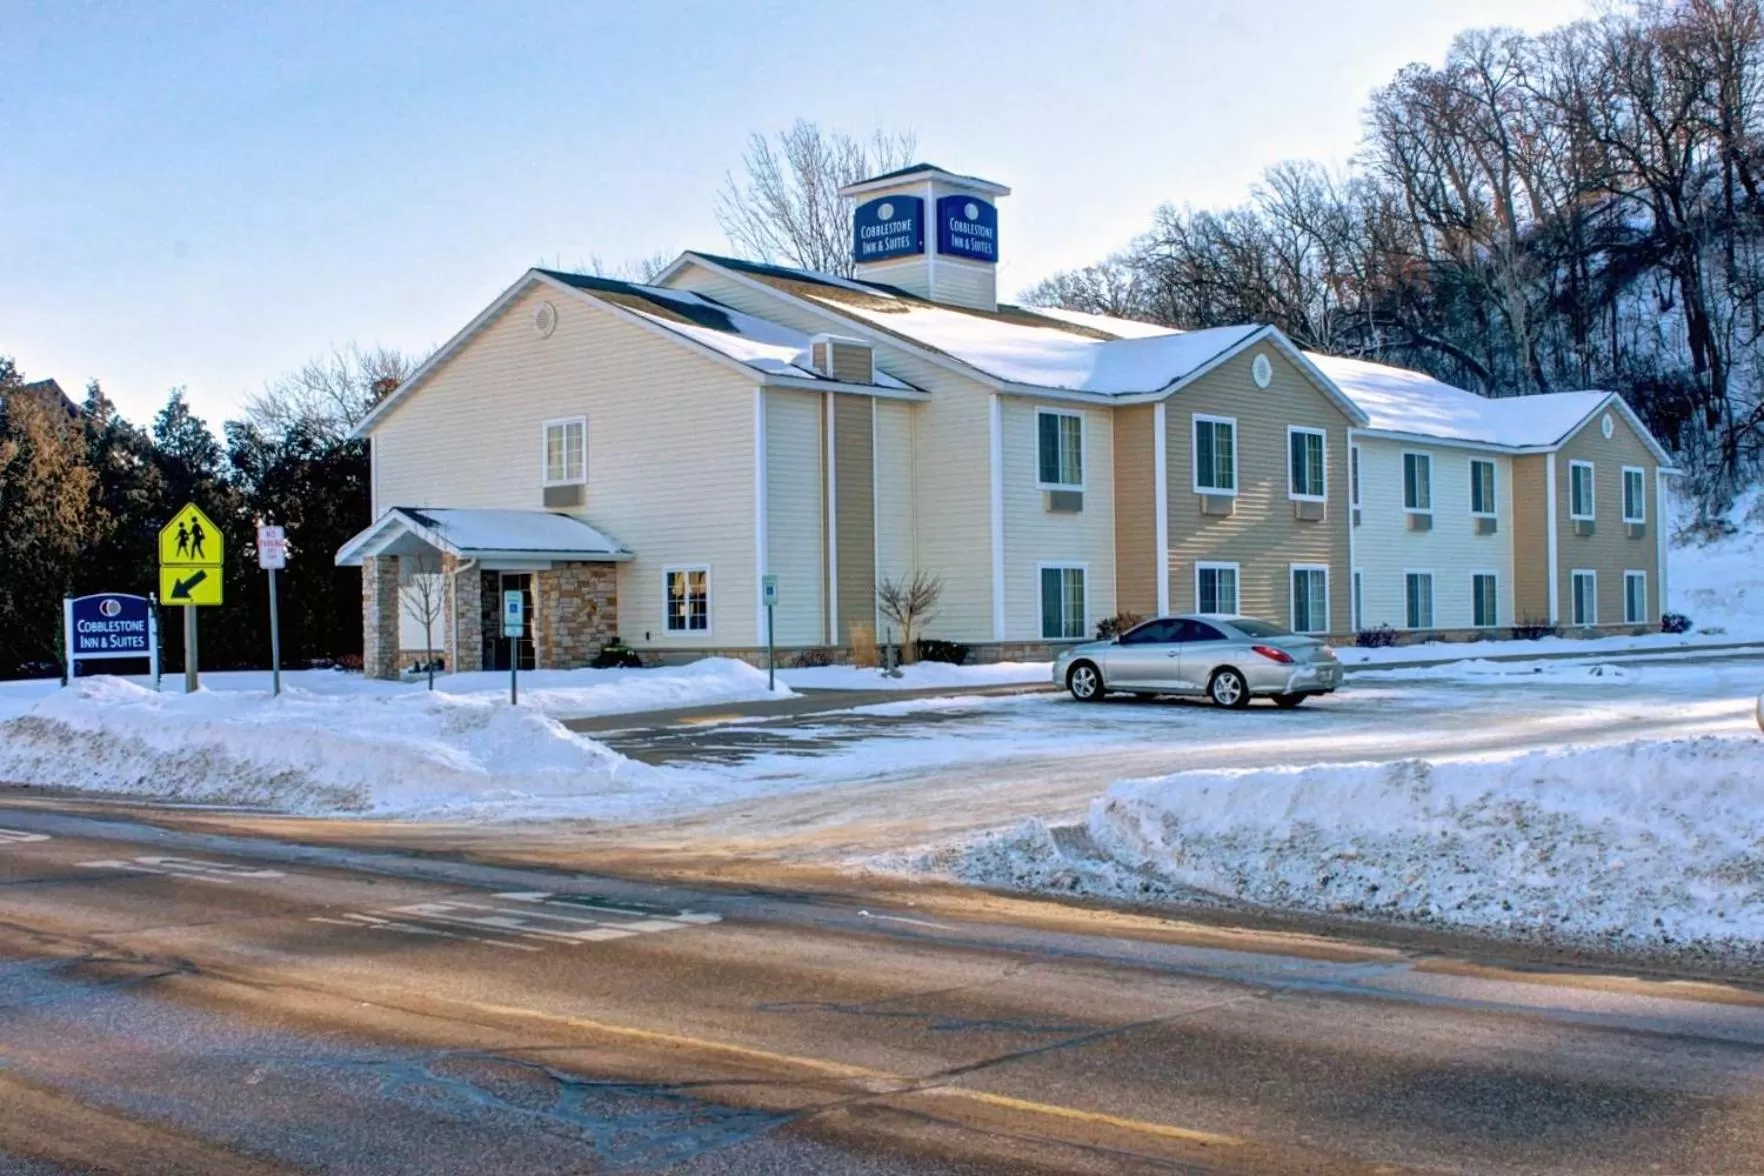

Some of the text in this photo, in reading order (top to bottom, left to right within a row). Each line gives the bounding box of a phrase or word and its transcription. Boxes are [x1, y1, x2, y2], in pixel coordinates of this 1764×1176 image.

[860, 219, 912, 239] COBBLESTONE
[950, 217, 993, 239] COBBLESTONE
[863, 235, 910, 255] INN & SUITES
[951, 233, 993, 254] INN & SUITES
[77, 619, 145, 633] COBBLESTONE
[80, 634, 145, 648] INN & SUITES
